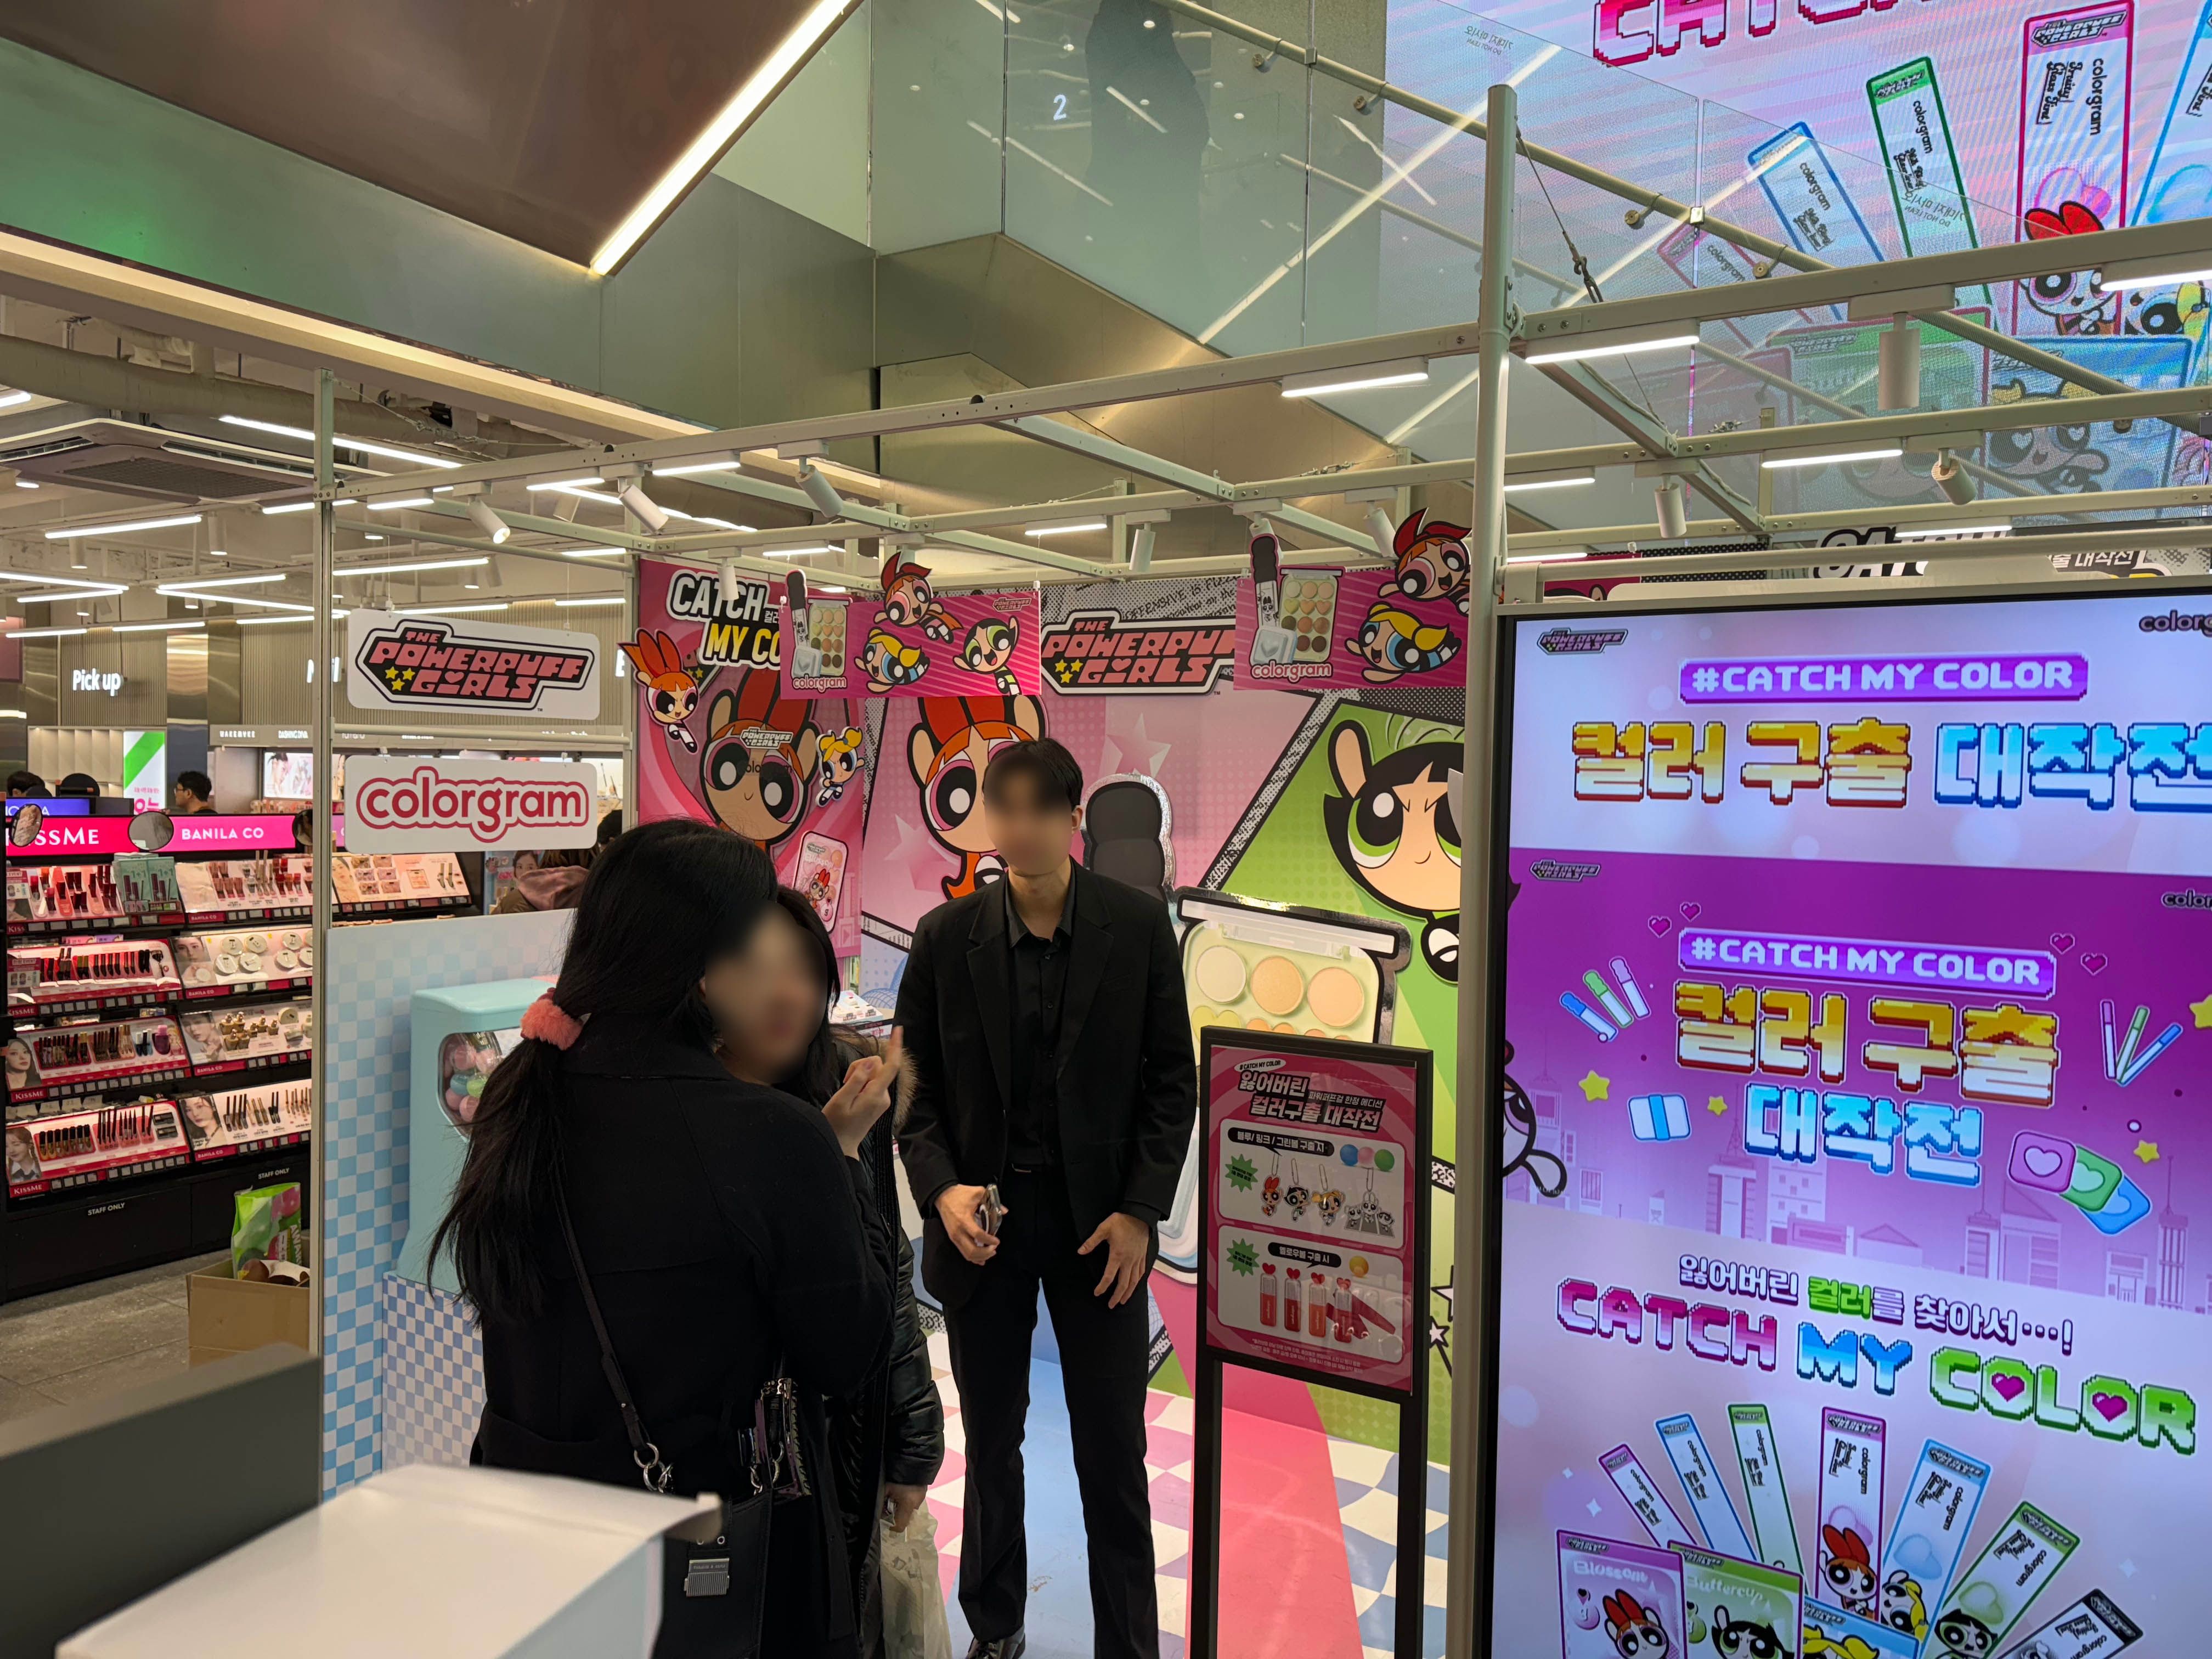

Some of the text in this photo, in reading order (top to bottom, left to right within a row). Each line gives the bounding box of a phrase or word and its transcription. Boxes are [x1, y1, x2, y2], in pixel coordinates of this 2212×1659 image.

[1053, 94, 1067, 120] 2
[2086, 58, 2108, 136] colorgram
[1912, 100, 1933, 154] colorgram
[1799, 162, 1831, 211] colorgram
[1707, 245, 1746, 282] colorgram
[404, 631, 441, 644] THE
[1075, 620, 1109, 631] THE
[705, 623, 749, 661] MY
[1041, 629, 1235, 658] POWERPUF
[368, 641, 586, 679] POWERPUFF
[1077, 657, 1214, 684] GIRLS
[1253, 662, 1331, 681] colorgram
[72, 668, 121, 697] Pick up
[410, 669, 538, 699] GIRLS
[793, 675, 847, 692] colorgram
[1691, 661, 2073, 692] #CATCH MY COLOR
[1573, 717, 2212, 813] 컬러 구출 대작전
[366, 776, 582, 833] colorgram
[182, 828, 238, 840] BANILA
[242, 827, 263, 839] CO
[1691, 937, 2040, 985] #CATCH MY COLOR
[1674, 980, 2061, 1107] 컬러 구출
[1240, 1071, 1307, 1097] 잃어버린
[1309, 1092, 1384, 1108] 파워퍼프걸 한정 에디션
[1324, 1105, 1381, 1131] 대작전
[1317, 1141, 1324, 1152] 시
[1744, 1082, 1982, 1186] 대작전
[275, 1167, 290, 1176] ONLY
[88, 1202, 125, 1216] STAFF ONLY
[1322, 1255, 1330, 1263] 시
[1680, 1255, 1798, 1306] 잃어버린
[1808, 1276, 1904, 1325] 컬러를
[1558, 1278, 2196, 1455] CATCH MY COLOR
[1687, 1440, 1707, 1477] colorgram
[1858, 1447, 1871, 1495] colorgram
[1943, 1486, 1964, 1531] colorgram
[1573, 1560, 1648, 1583] Blossom
[2015, 1549, 2047, 1587] colorgram
